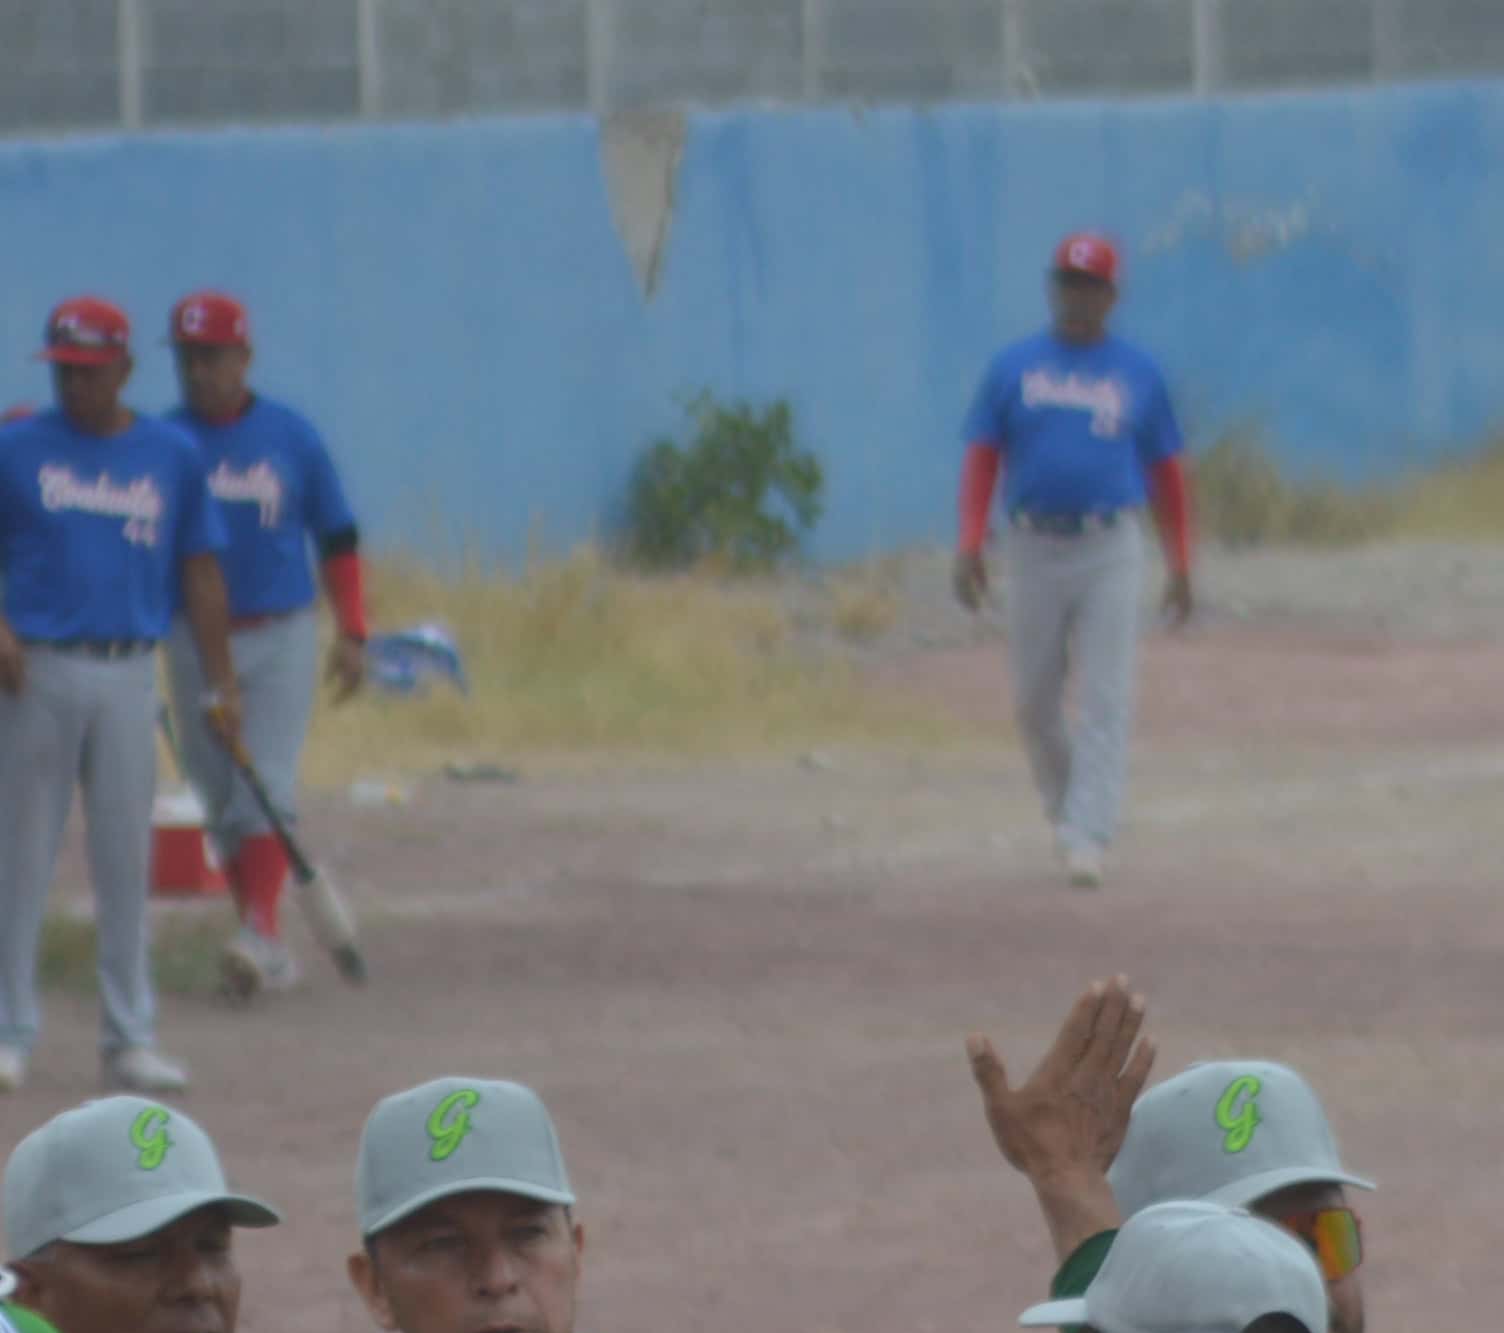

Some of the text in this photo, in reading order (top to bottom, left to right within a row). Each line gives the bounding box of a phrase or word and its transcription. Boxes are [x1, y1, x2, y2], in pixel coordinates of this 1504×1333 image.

[130, 1105, 174, 1171] G
[426, 1088, 480, 1161] G
[1216, 1075, 1261, 1153] G
